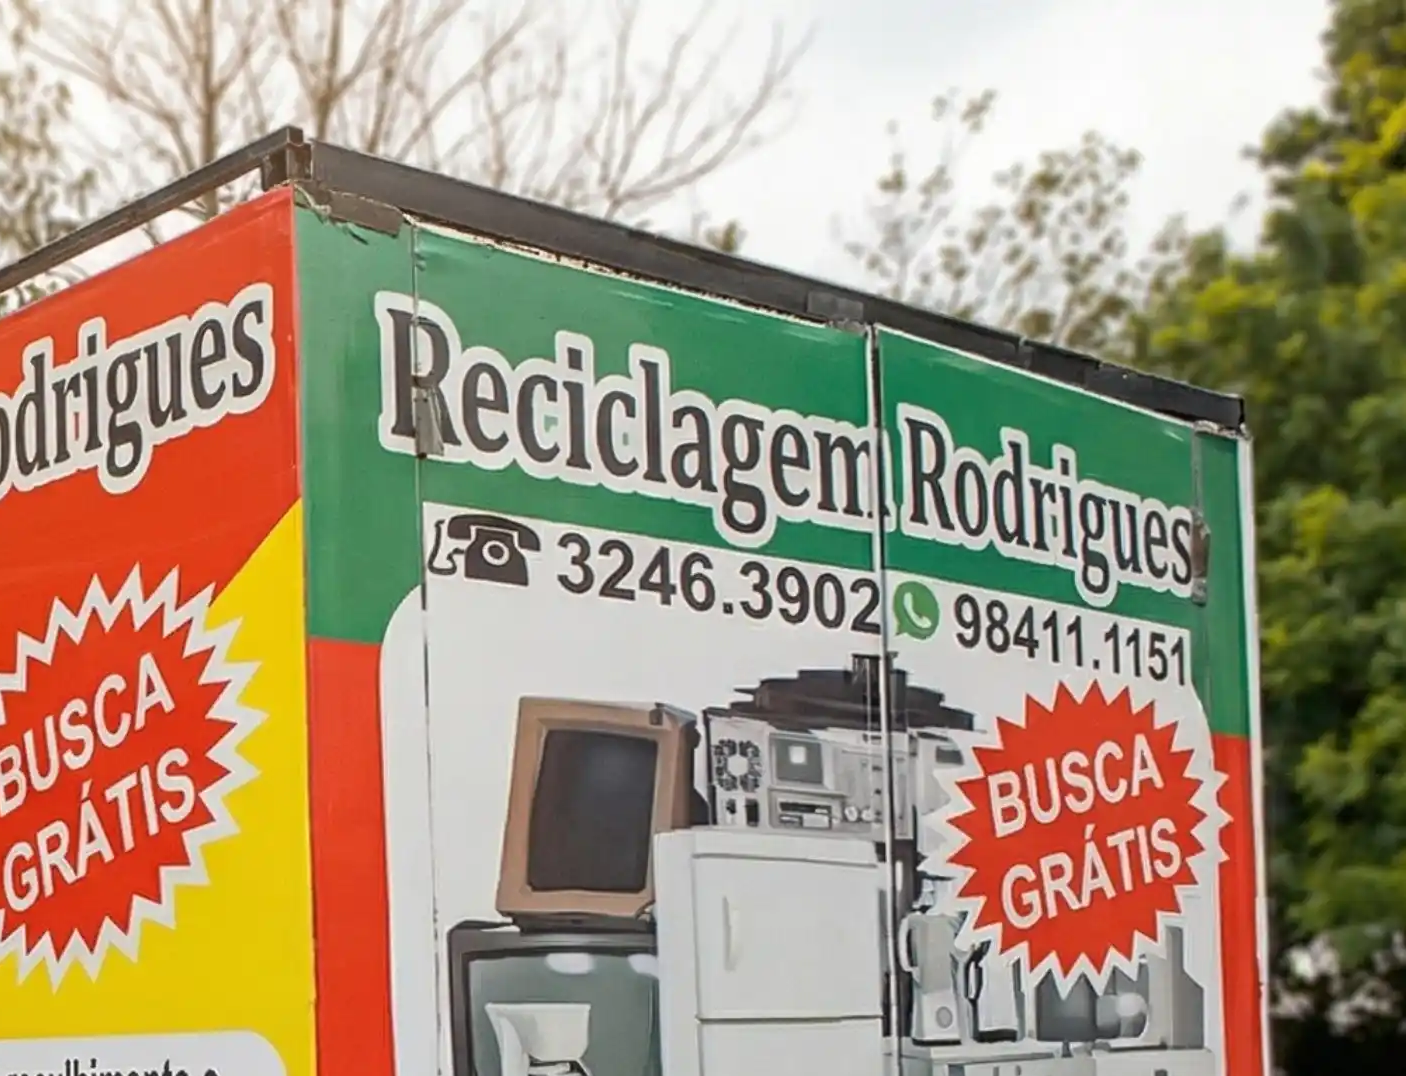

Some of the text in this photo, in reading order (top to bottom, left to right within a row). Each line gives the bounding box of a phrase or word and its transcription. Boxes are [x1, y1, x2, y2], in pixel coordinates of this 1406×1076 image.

[386, 307, 1193, 595] Reciclagem Rodrigues
[557, 532, 1185, 686] 3246.3902 98411.1151
[2, 748, 196, 912] GRÁTIS
[987, 733, 1164, 838] BUSCA
[1001, 817, 1182, 929] GRÁTIS
